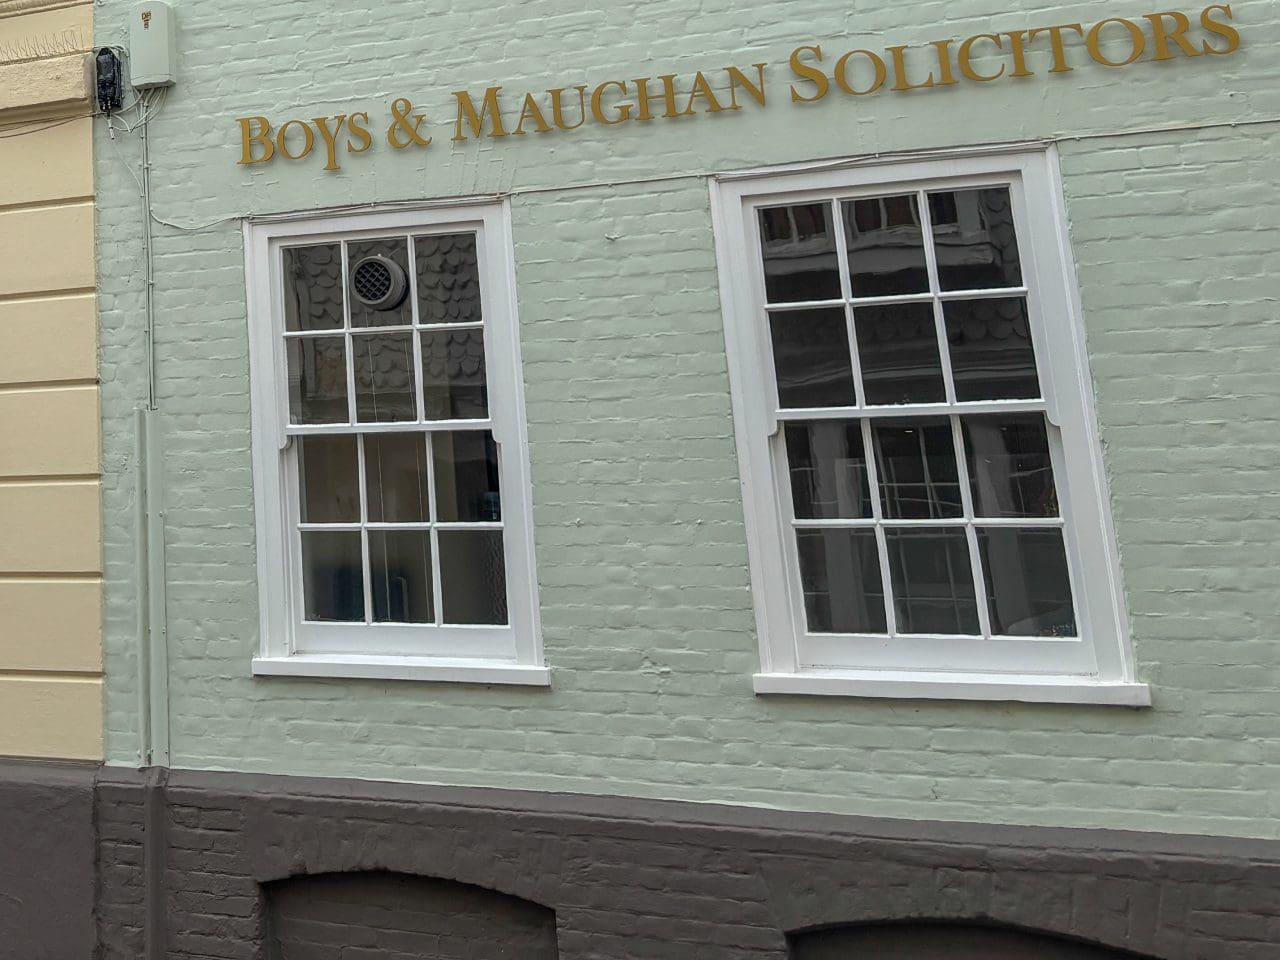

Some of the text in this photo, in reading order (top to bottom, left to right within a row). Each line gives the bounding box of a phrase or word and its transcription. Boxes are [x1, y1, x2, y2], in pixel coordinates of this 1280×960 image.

[235, 4, 1241, 171] BOYS & MAUGHAN SOLICITORS
